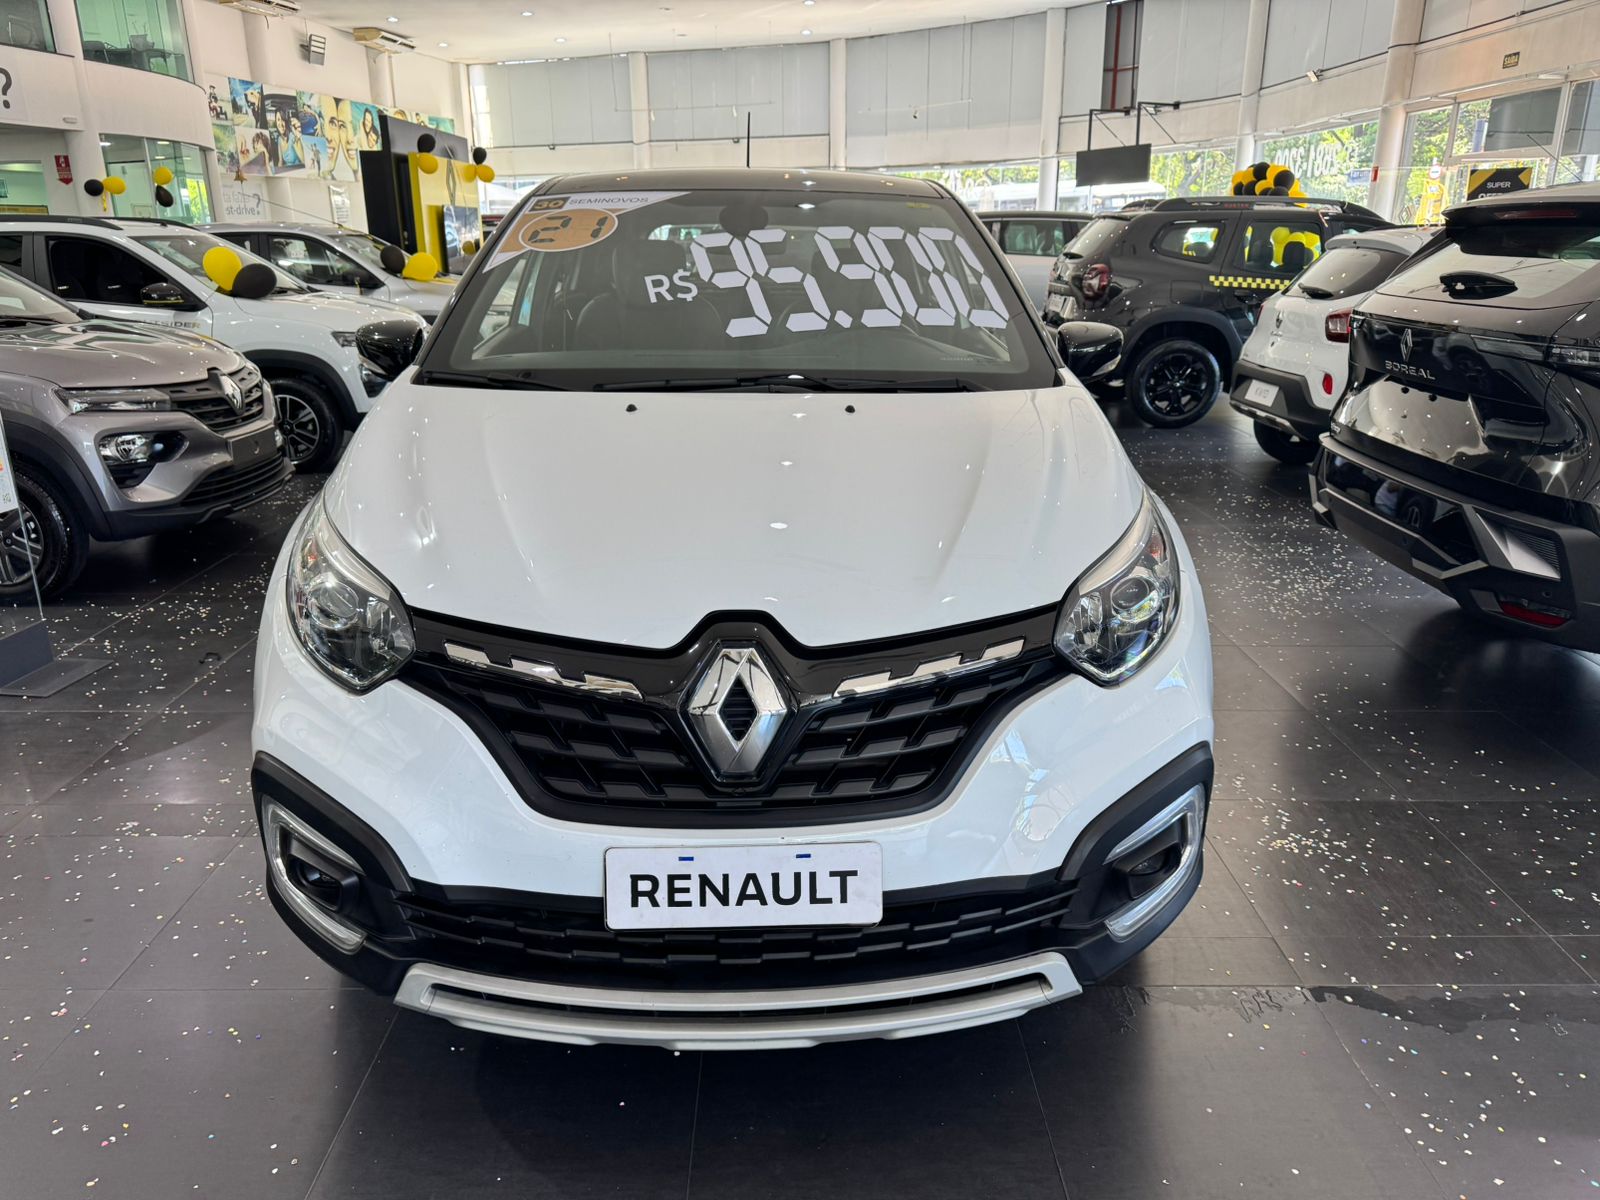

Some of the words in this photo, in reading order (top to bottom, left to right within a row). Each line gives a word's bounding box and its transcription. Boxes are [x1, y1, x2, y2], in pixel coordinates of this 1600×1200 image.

[1486, 181, 1512, 189] SUPER
[569, 197, 649, 205] SEMINOVOS
[528, 215, 608, 244] 21
[644, 268, 698, 303] R$
[690, 226, 1010, 338] 95.900
[1385, 360, 1436, 381] BOREAL
[629, 869, 859, 908] RENAULT
